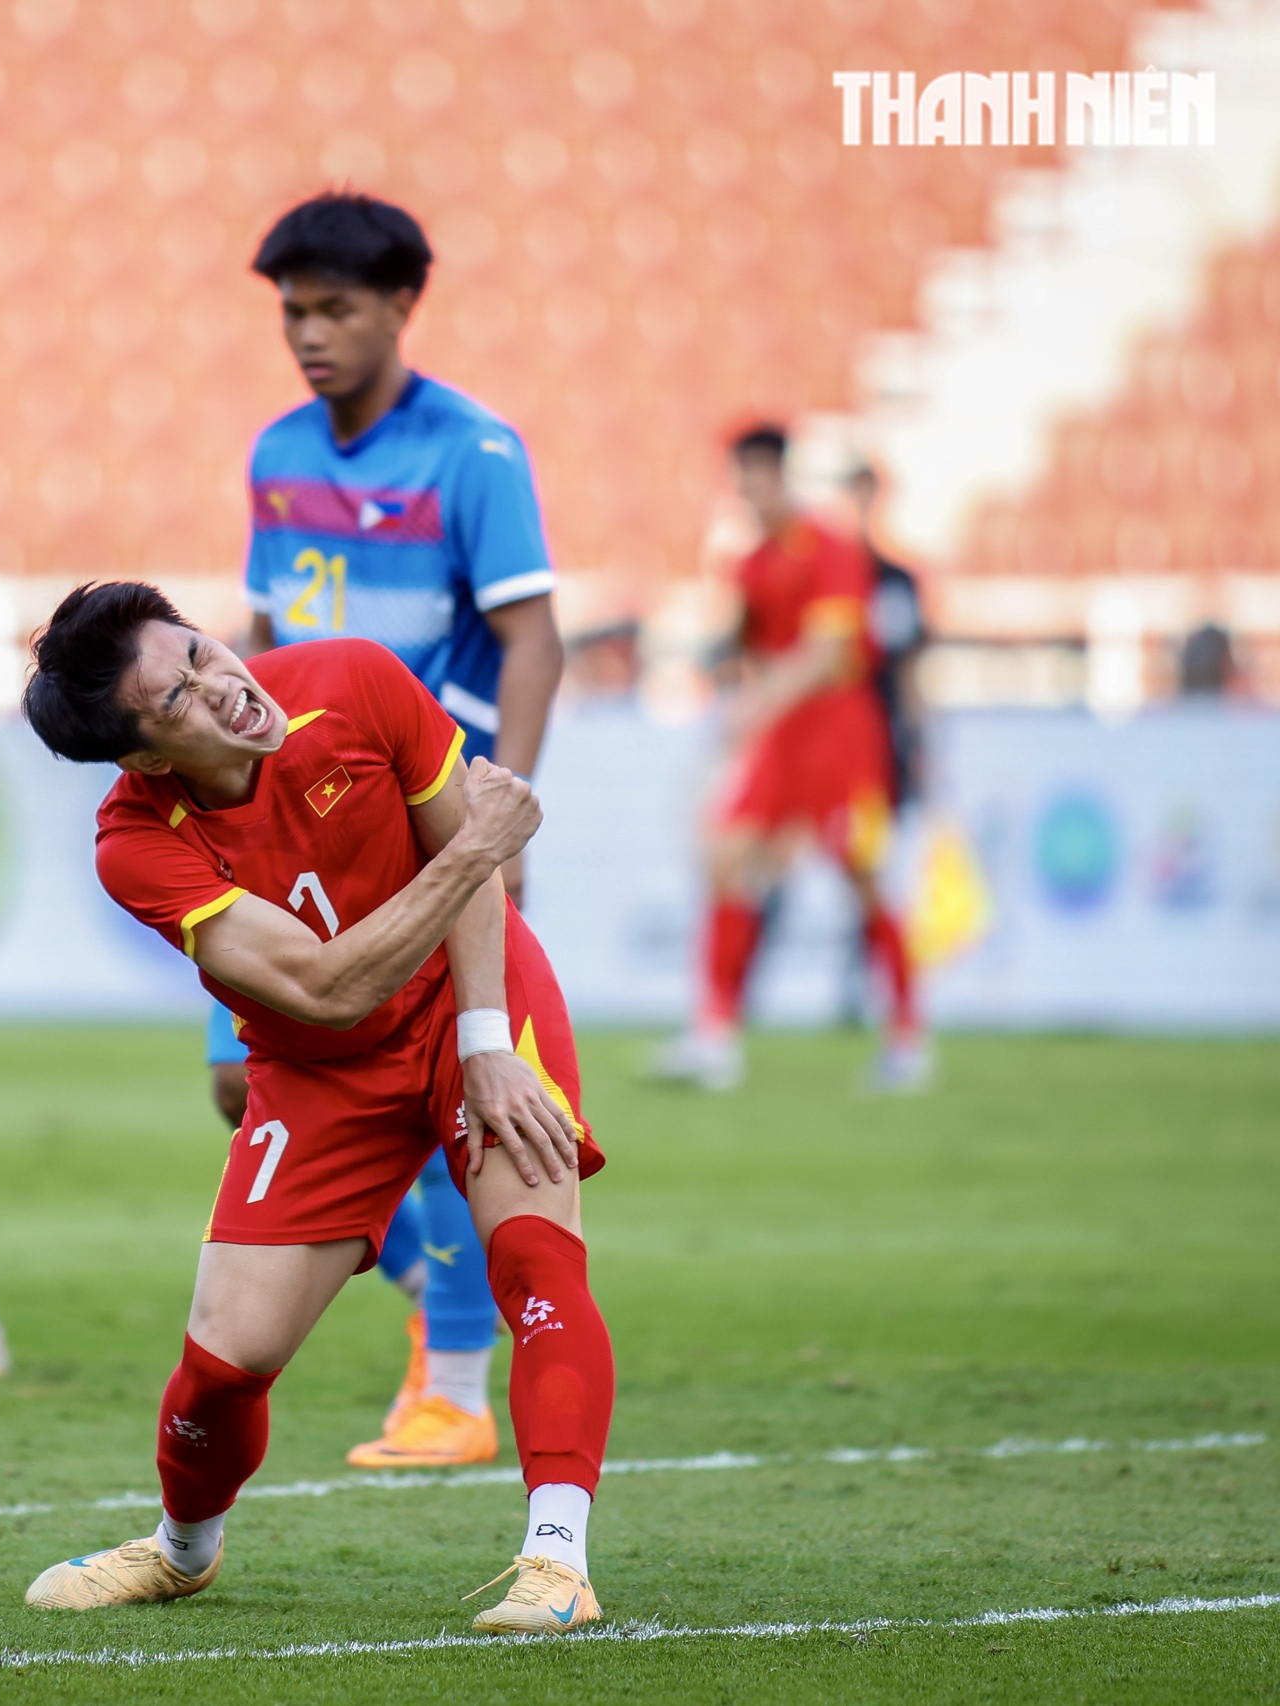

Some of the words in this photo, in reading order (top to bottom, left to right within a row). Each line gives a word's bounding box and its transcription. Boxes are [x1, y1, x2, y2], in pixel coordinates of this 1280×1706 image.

[286, 548, 347, 632] 21
[287, 871, 340, 939] 7
[246, 1119, 290, 1204] 7
